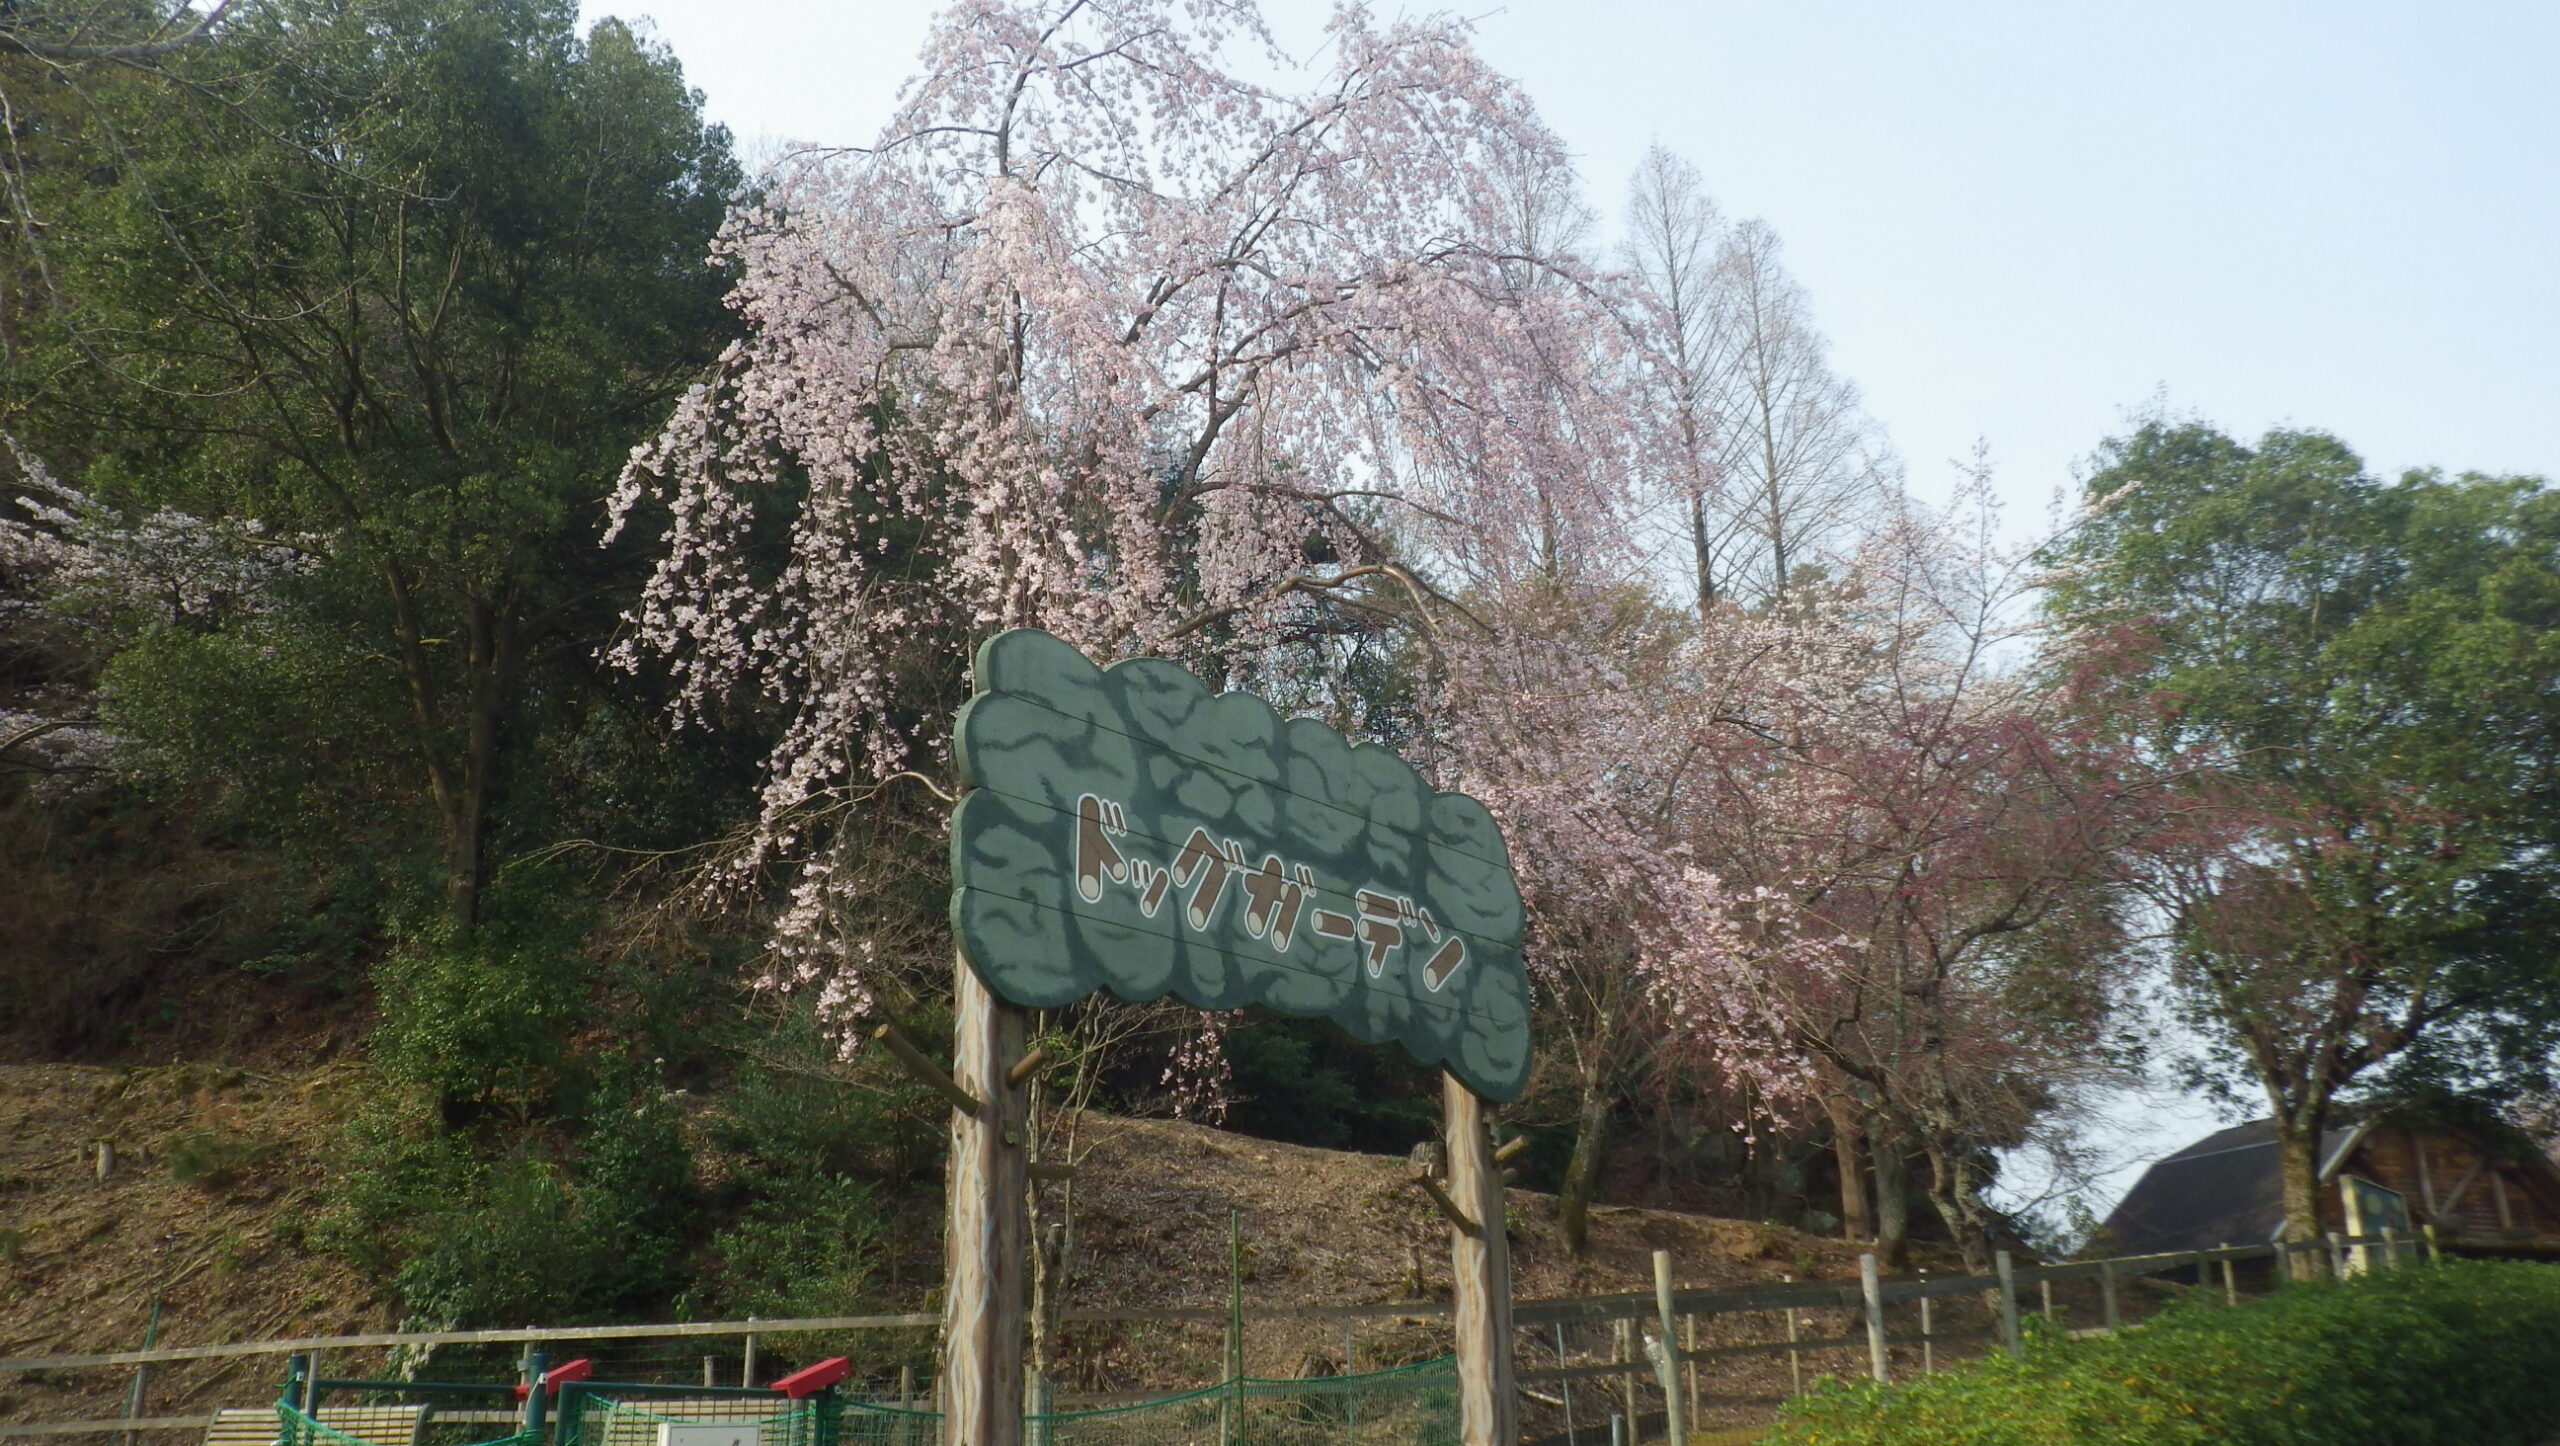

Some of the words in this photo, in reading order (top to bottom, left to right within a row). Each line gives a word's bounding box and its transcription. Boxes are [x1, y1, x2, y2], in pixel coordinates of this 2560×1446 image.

[1078, 793, 1465, 991] ドッグガーデン
